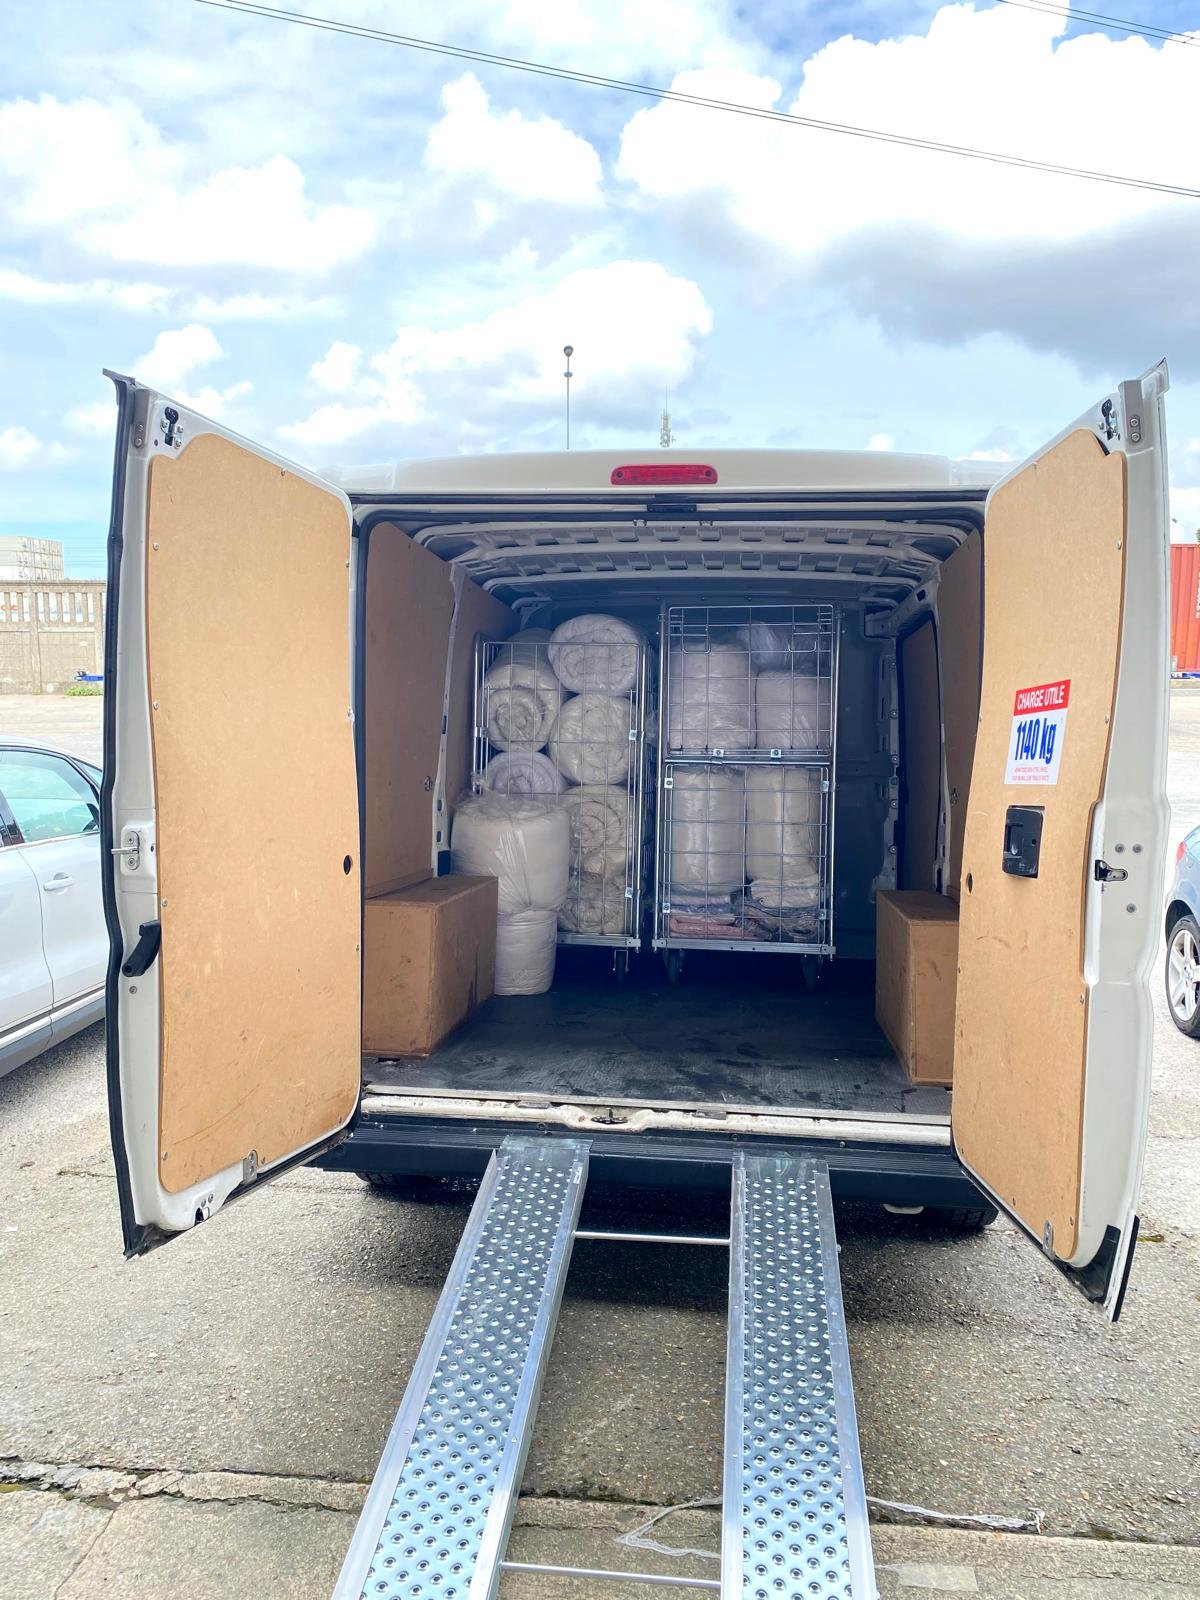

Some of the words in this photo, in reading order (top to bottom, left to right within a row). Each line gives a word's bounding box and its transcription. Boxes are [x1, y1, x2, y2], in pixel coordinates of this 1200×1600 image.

[1017, 690, 1044, 710] CHARGE
[1044, 685, 1066, 706] UTILE
[1015, 719, 1040, 760] 1140
[1039, 718, 1057, 764] kg
